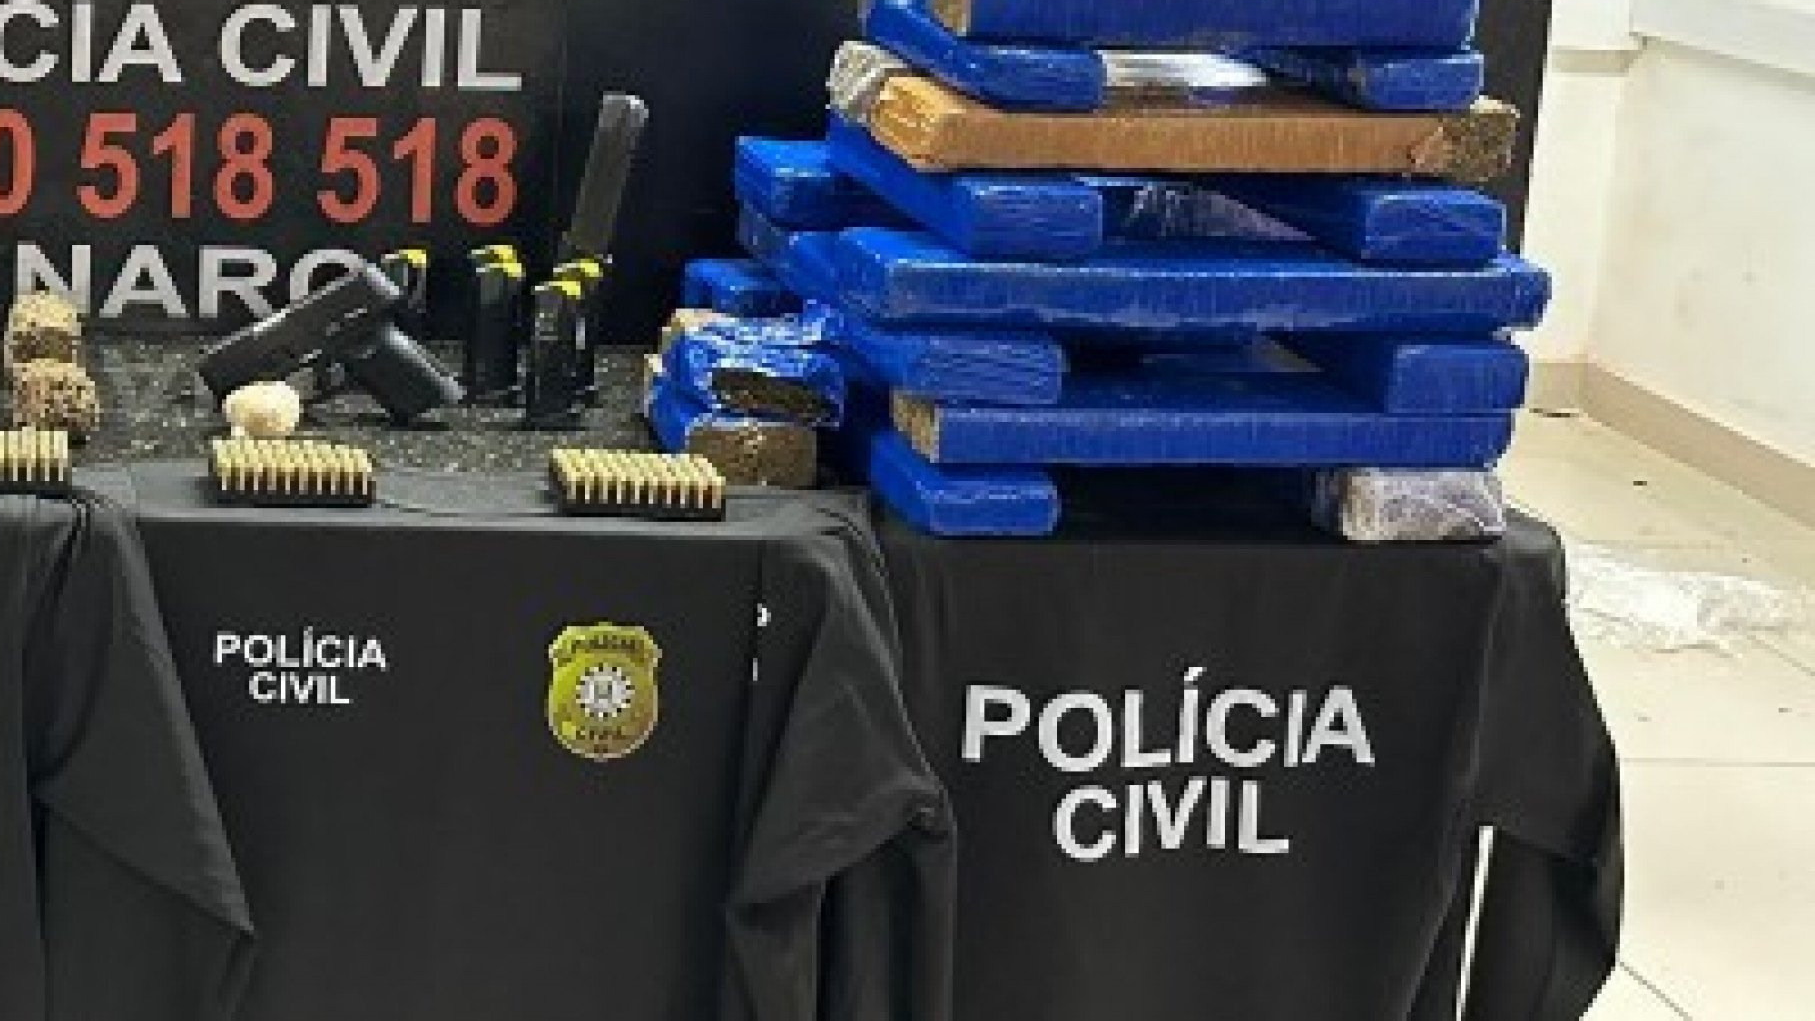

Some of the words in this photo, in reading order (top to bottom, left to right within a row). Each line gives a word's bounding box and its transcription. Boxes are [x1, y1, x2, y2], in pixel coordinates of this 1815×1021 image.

[220, 2, 523, 92] CIVIL
[76, 112, 275, 221] 518
[315, 116, 519, 225] 518
[213, 625, 390, 672] POLÍCIA
[248, 670, 354, 704] CIVIL
[961, 666, 1375, 772] POLÍCIA
[1053, 776, 1289, 862] CIVIL
